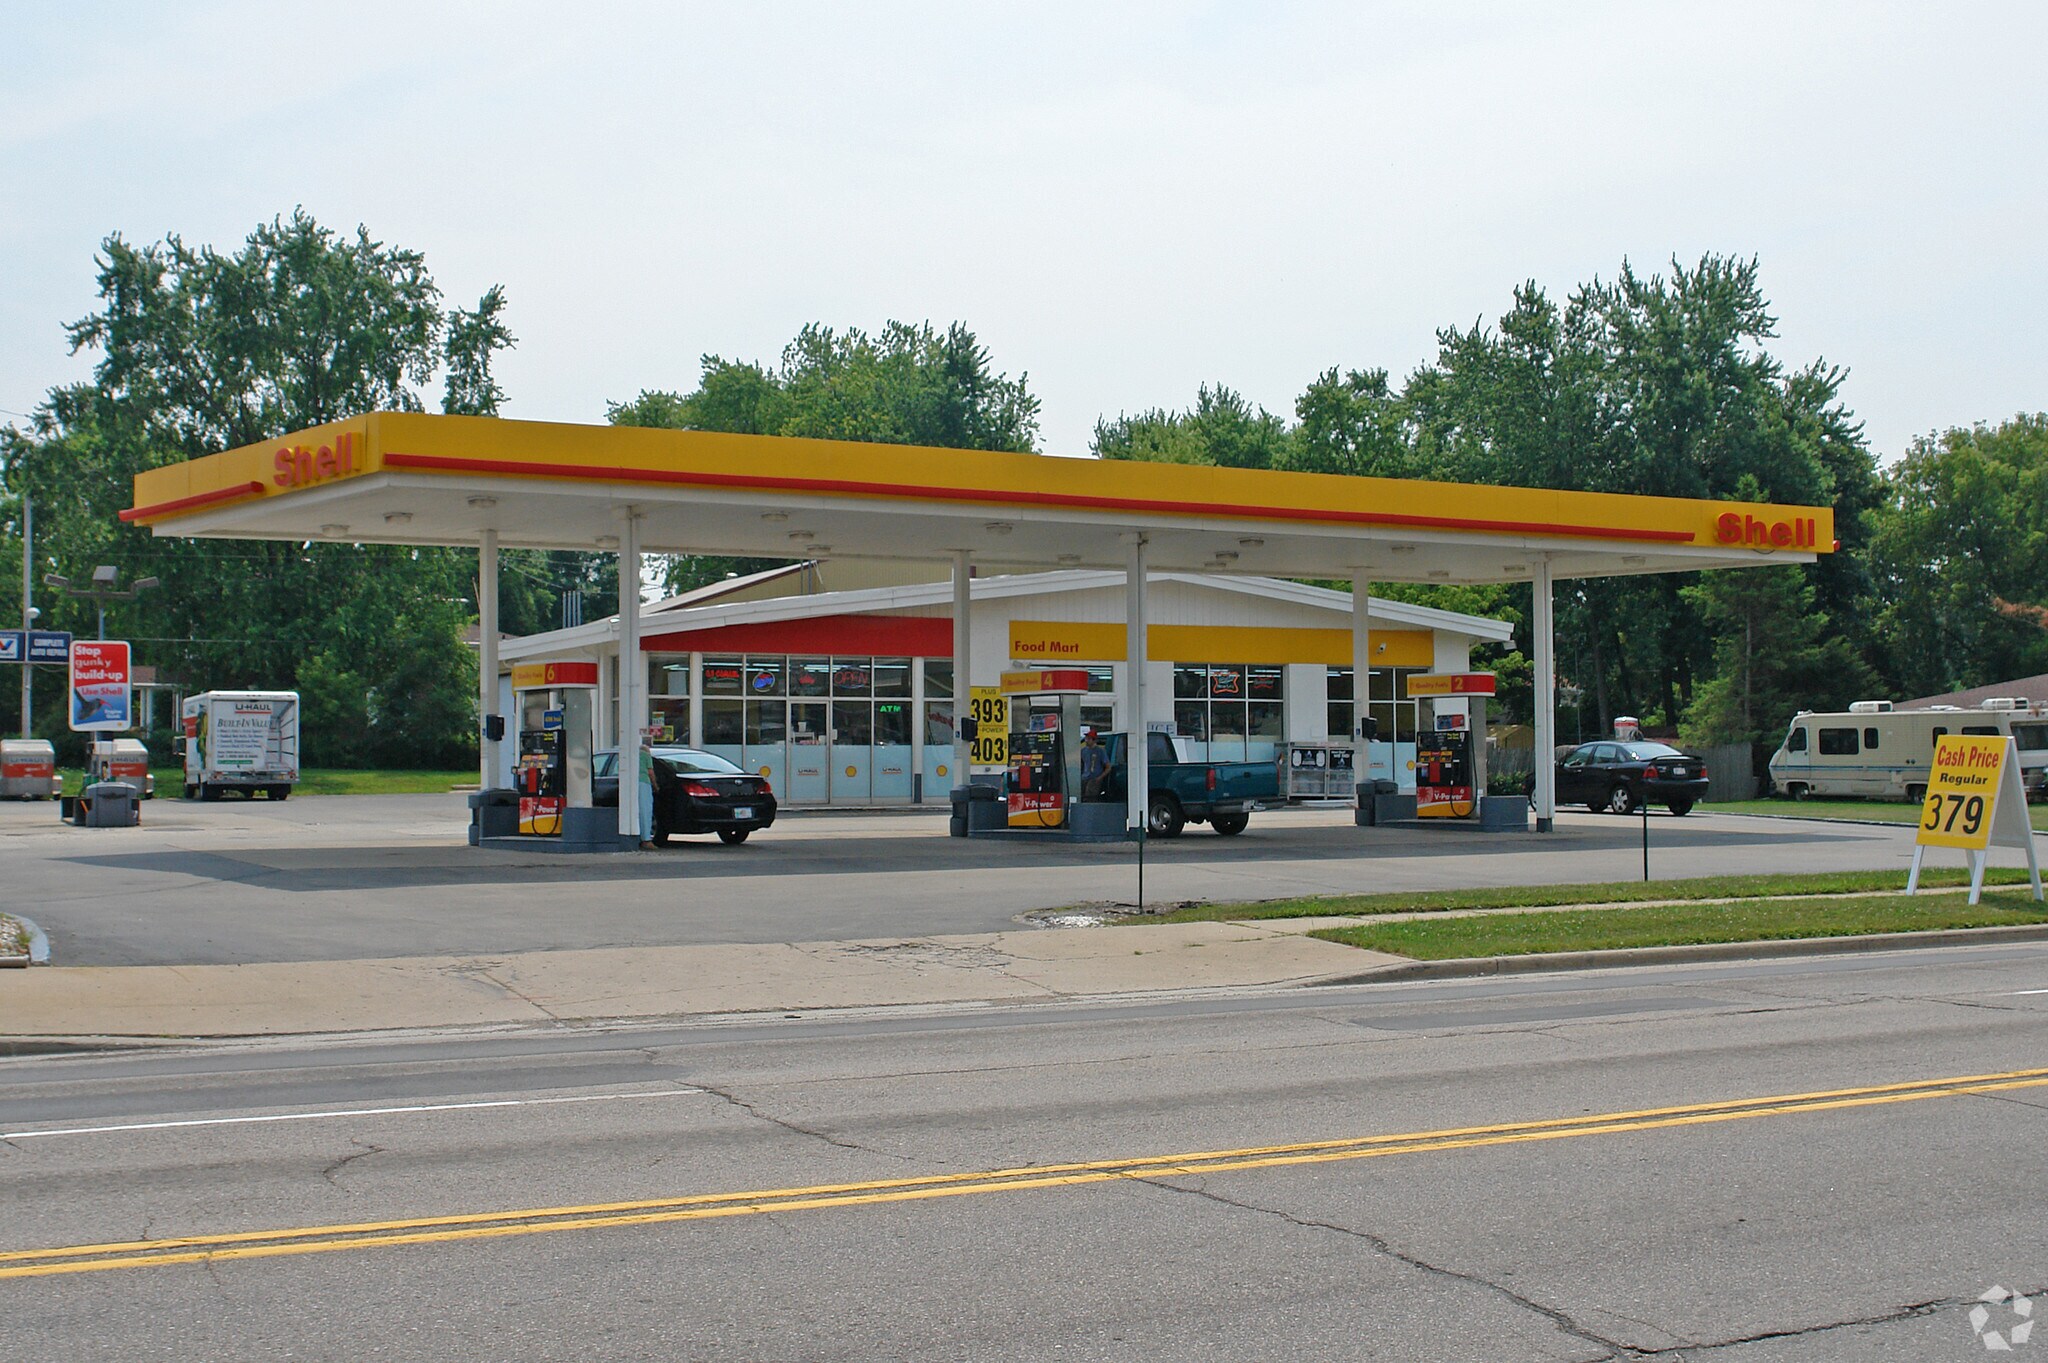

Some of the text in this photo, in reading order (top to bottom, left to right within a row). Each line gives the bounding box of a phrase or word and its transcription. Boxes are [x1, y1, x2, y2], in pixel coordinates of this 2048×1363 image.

[273, 431, 352, 487] Shell
[1717, 512, 1815, 547] Shell
[75, 646, 101, 658] Stop
[1015, 641, 1079, 653] Food Mart
[75, 659, 112, 668] gunky
[75, 669, 123, 682] build-up
[547, 665, 555, 681] 6
[834, 671, 868, 684] OPEN
[1043, 673, 1054, 687] 4
[1415, 681, 1434, 689] Quality
[1454, 677, 1463, 690] 2
[82, 687, 123, 696] Use Shell
[971, 698, 1004, 723] 393
[217, 718, 250, 728] BUILT-IN
[1151, 724, 1174, 734] ICE
[971, 737, 1004, 762] 403
[1937, 744, 1999, 768] Cash Price
[1939, 773, 1988, 786] Regular
[1924, 794, 1984, 835] 379
